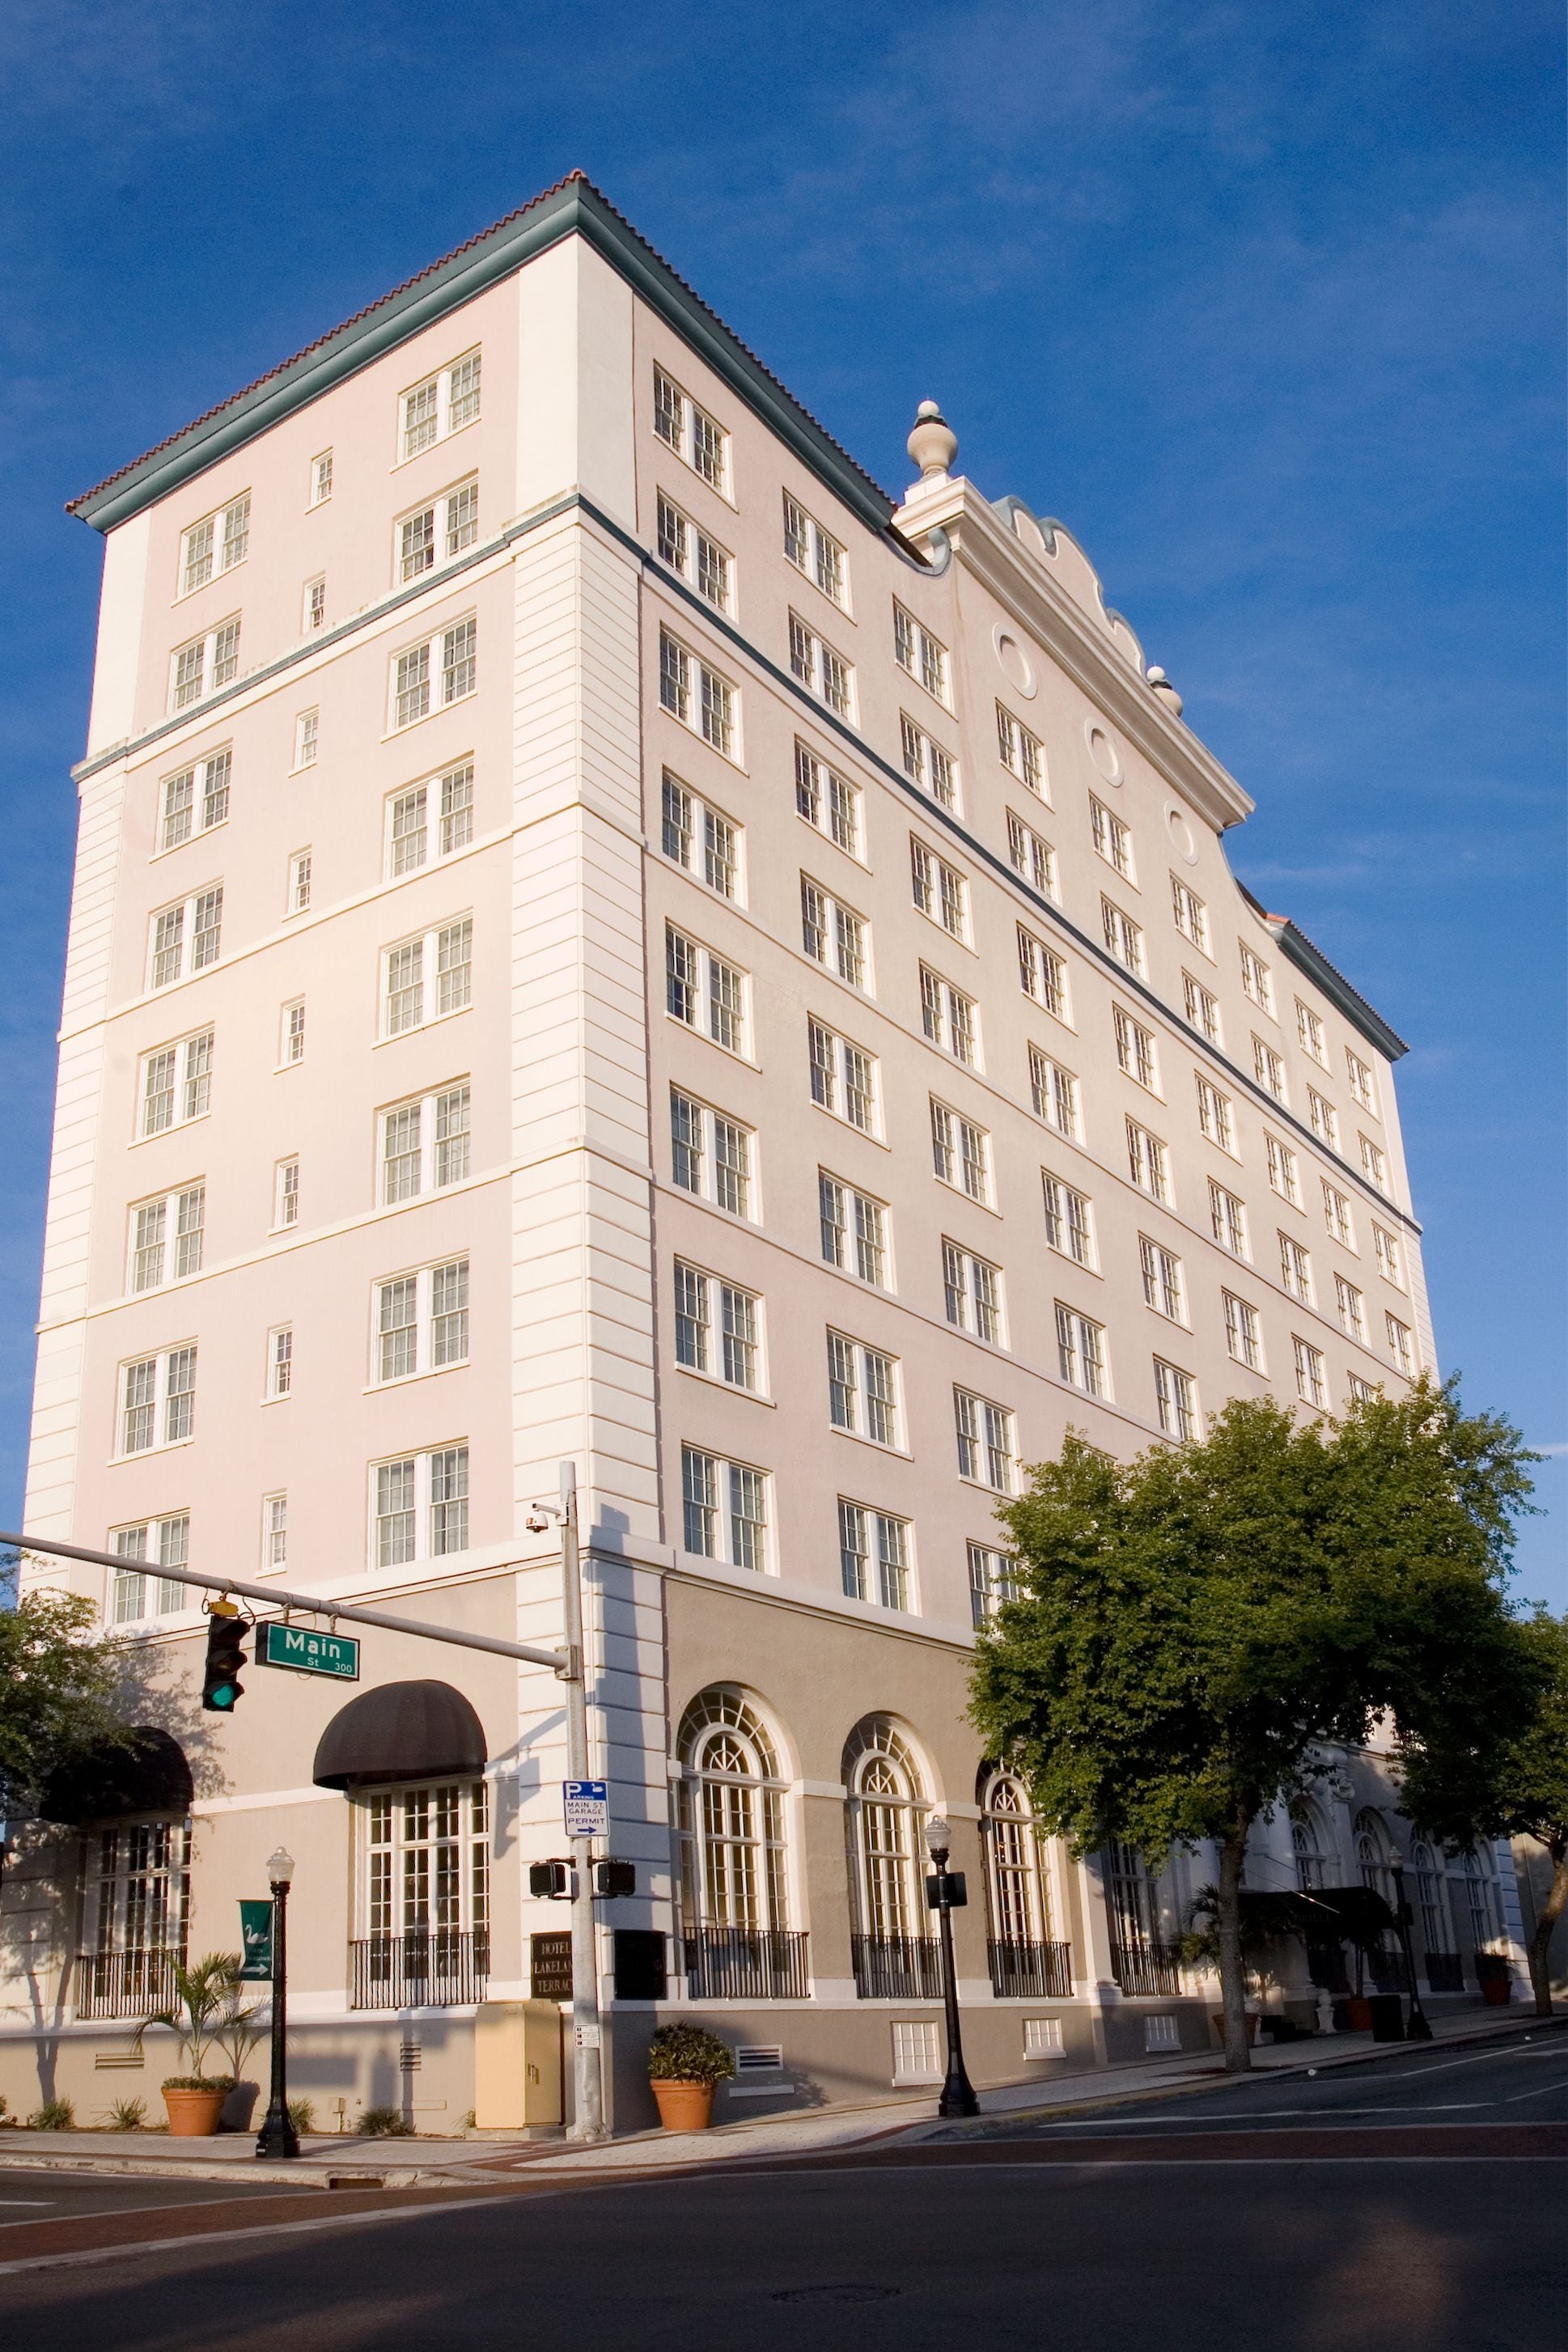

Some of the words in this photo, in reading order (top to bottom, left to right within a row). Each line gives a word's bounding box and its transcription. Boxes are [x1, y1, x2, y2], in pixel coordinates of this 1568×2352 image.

[286, 1631, 340, 1659] Main
[307, 1657, 319, 1667] St
[335, 1663, 352, 1672] 300
[542, 1942, 571, 1955] HOTEL
[537, 1979, 572, 1992] TERRAC
